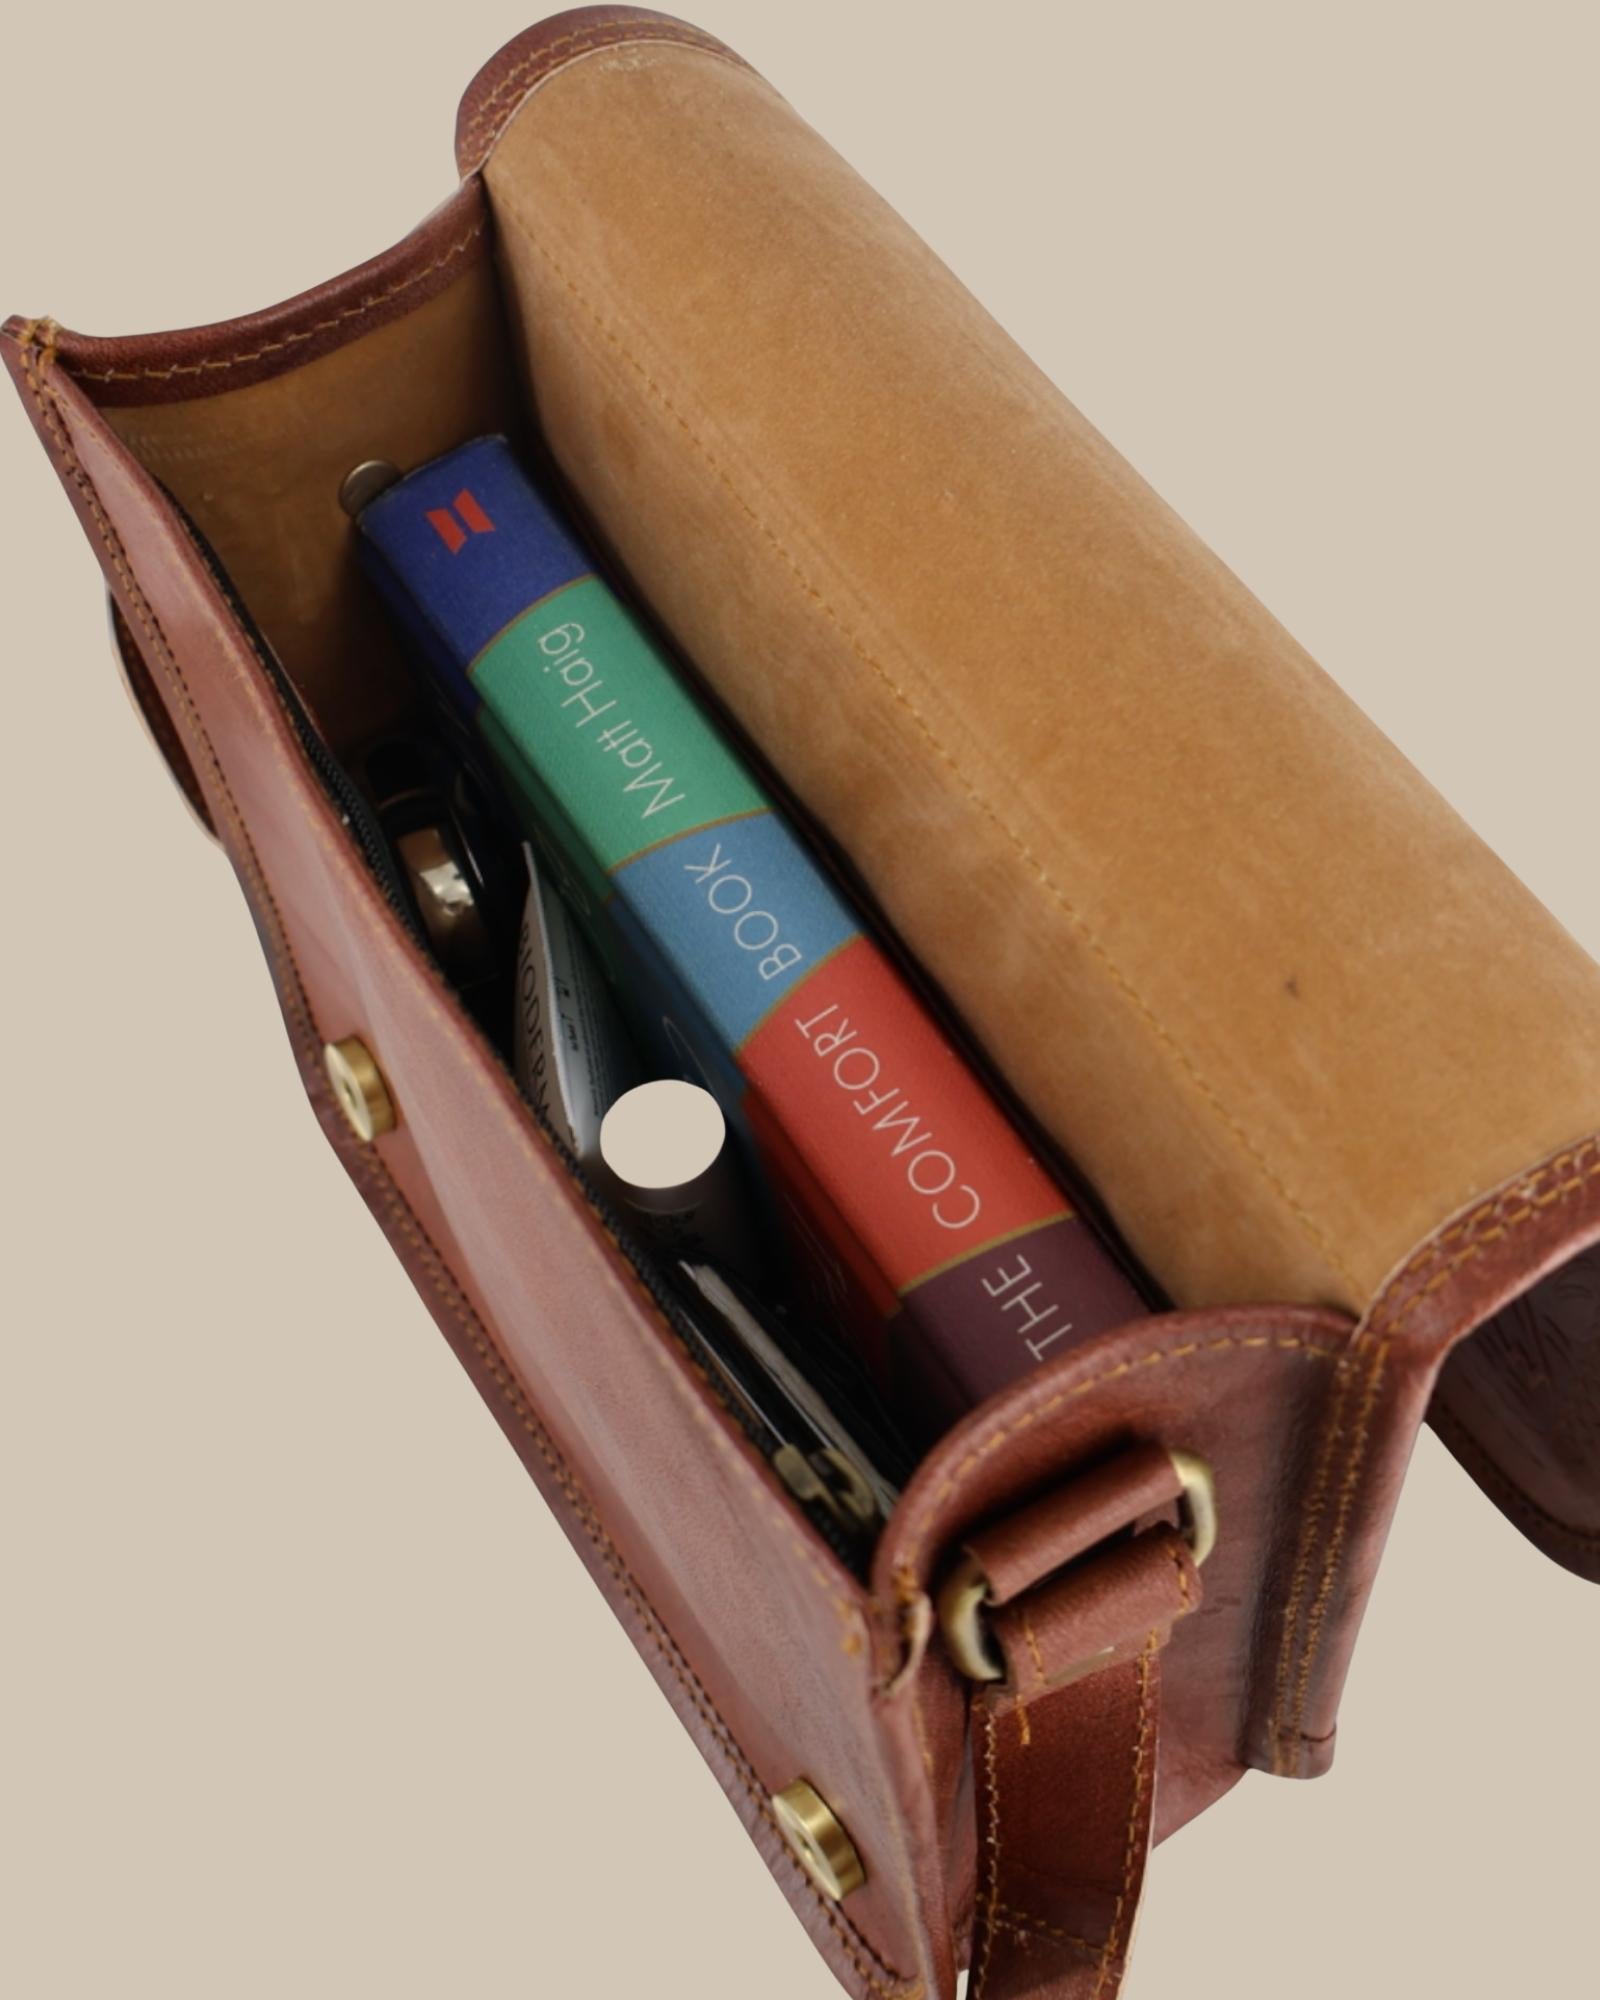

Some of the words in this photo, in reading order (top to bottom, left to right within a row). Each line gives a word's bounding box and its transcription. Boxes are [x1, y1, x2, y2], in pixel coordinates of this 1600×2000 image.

[538, 622, 616, 727] Haig
[597, 721, 685, 818] Matt
[685, 844, 802, 980] BOOK
[795, 1004, 980, 1229] COMFORT
[982, 1255, 1072, 1361] THE
